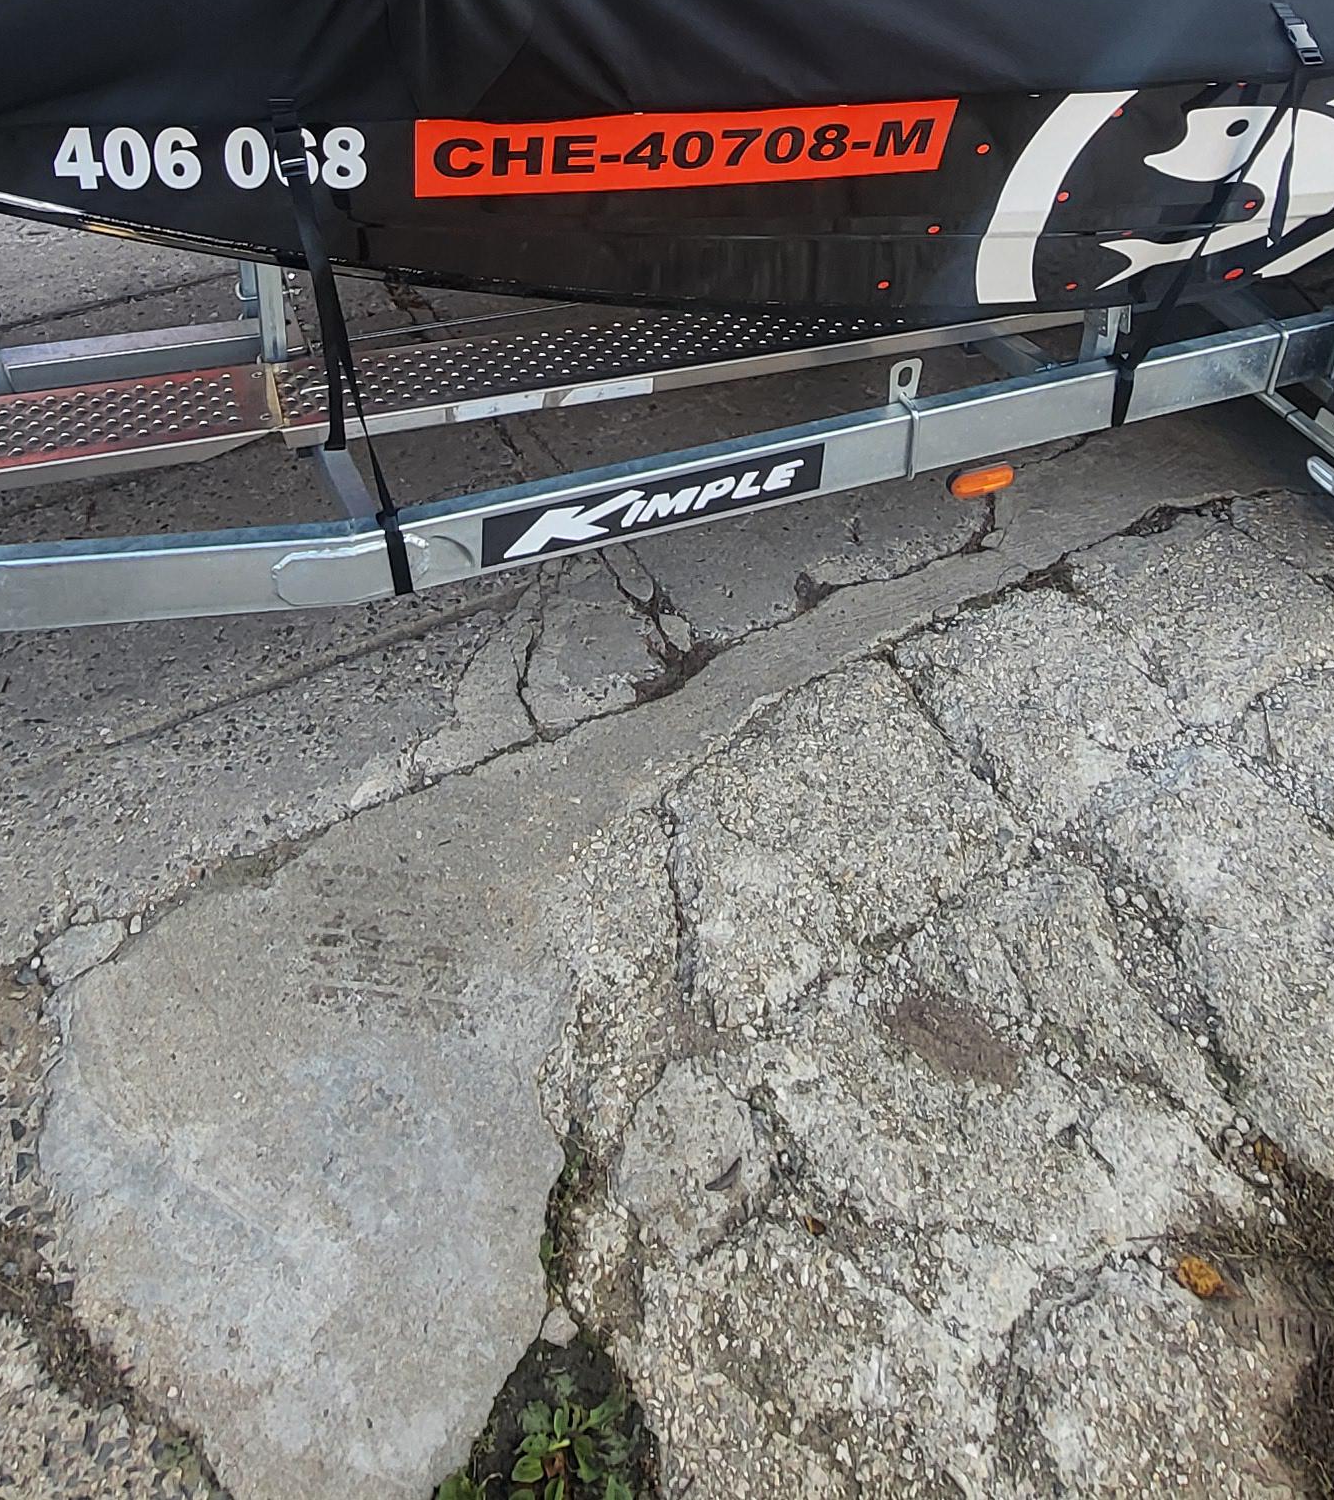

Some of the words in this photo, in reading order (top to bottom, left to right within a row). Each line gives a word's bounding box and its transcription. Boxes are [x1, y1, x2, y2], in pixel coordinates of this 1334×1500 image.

[53, 126, 202, 190] 406
[432, 117, 936, 178] CHE-40708-M
[503, 458, 805, 559] KIMPLE
